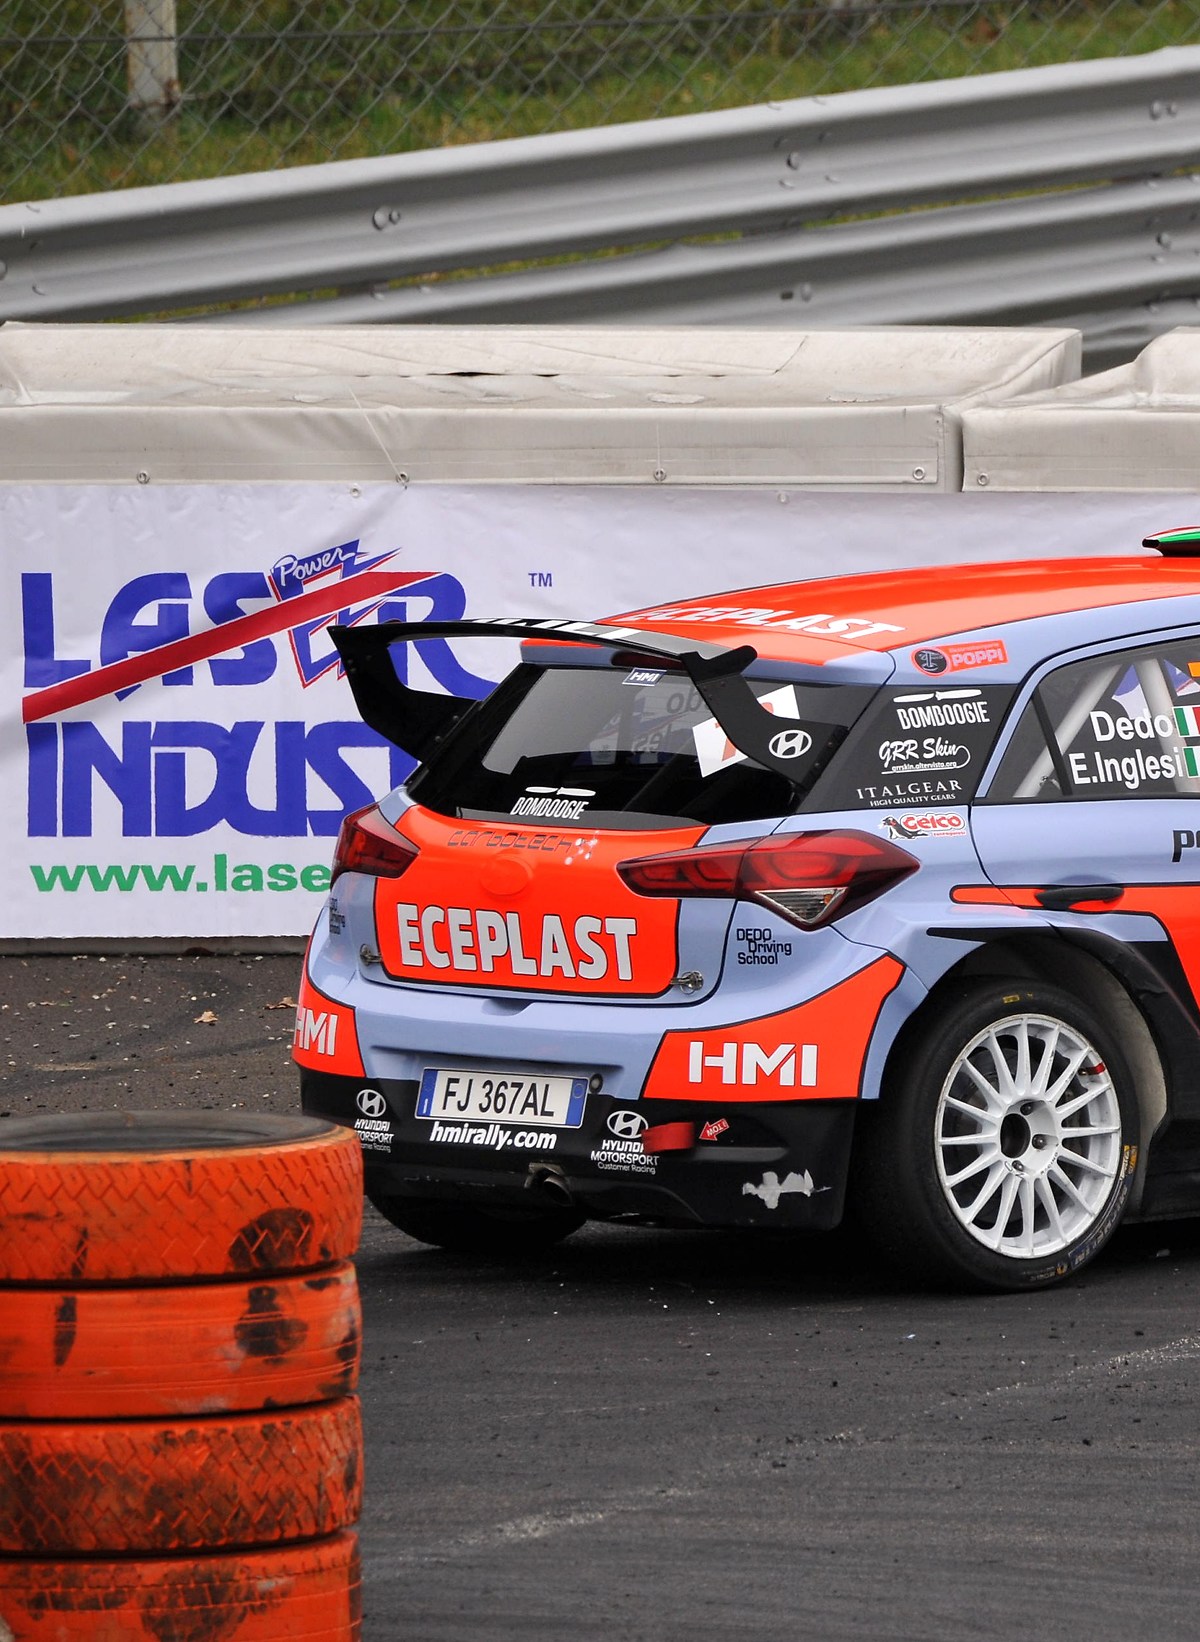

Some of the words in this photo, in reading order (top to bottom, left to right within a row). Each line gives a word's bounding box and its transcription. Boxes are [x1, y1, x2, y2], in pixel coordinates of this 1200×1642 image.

[273, 547, 357, 587] Power
[529, 573, 552, 587] TM
[613, 606, 906, 640] ECEPLAST
[629, 671, 659, 682] HMI
[897, 701, 990, 730] BOMBOOGIE
[1090, 709, 1173, 741] Dedo
[923, 737, 959, 759] Skin
[1068, 746, 1185, 789] E.Inglesi
[856, 780, 962, 799] ITALGEAR
[510, 797, 589, 820] BOMBOOGIE
[870, 799, 892, 807] HIGH
[893, 796, 929, 804] QUALITY
[931, 793, 956, 801] GEARS
[396, 902, 637, 981] ECEPLAST
[736, 928, 772, 942] DEDO
[748, 940, 792, 956] Driving
[737, 952, 778, 965] School
[293, 1006, 338, 1056] HMI
[689, 1041, 818, 1087] HMI
[442, 1077, 473, 1112] FJ
[478, 1079, 555, 1117] 367AL
[354, 1118, 390, 1132] HYUNDAI
[356, 1130, 395, 1143] TORSPORT
[429, 1121, 557, 1151] hmirally.com
[602, 1140, 644, 1152] HYUND
[591, 1150, 660, 1166] MOTORSPORT
[598, 1162, 630, 1172] Customer
[632, 1163, 656, 1175] Racing
